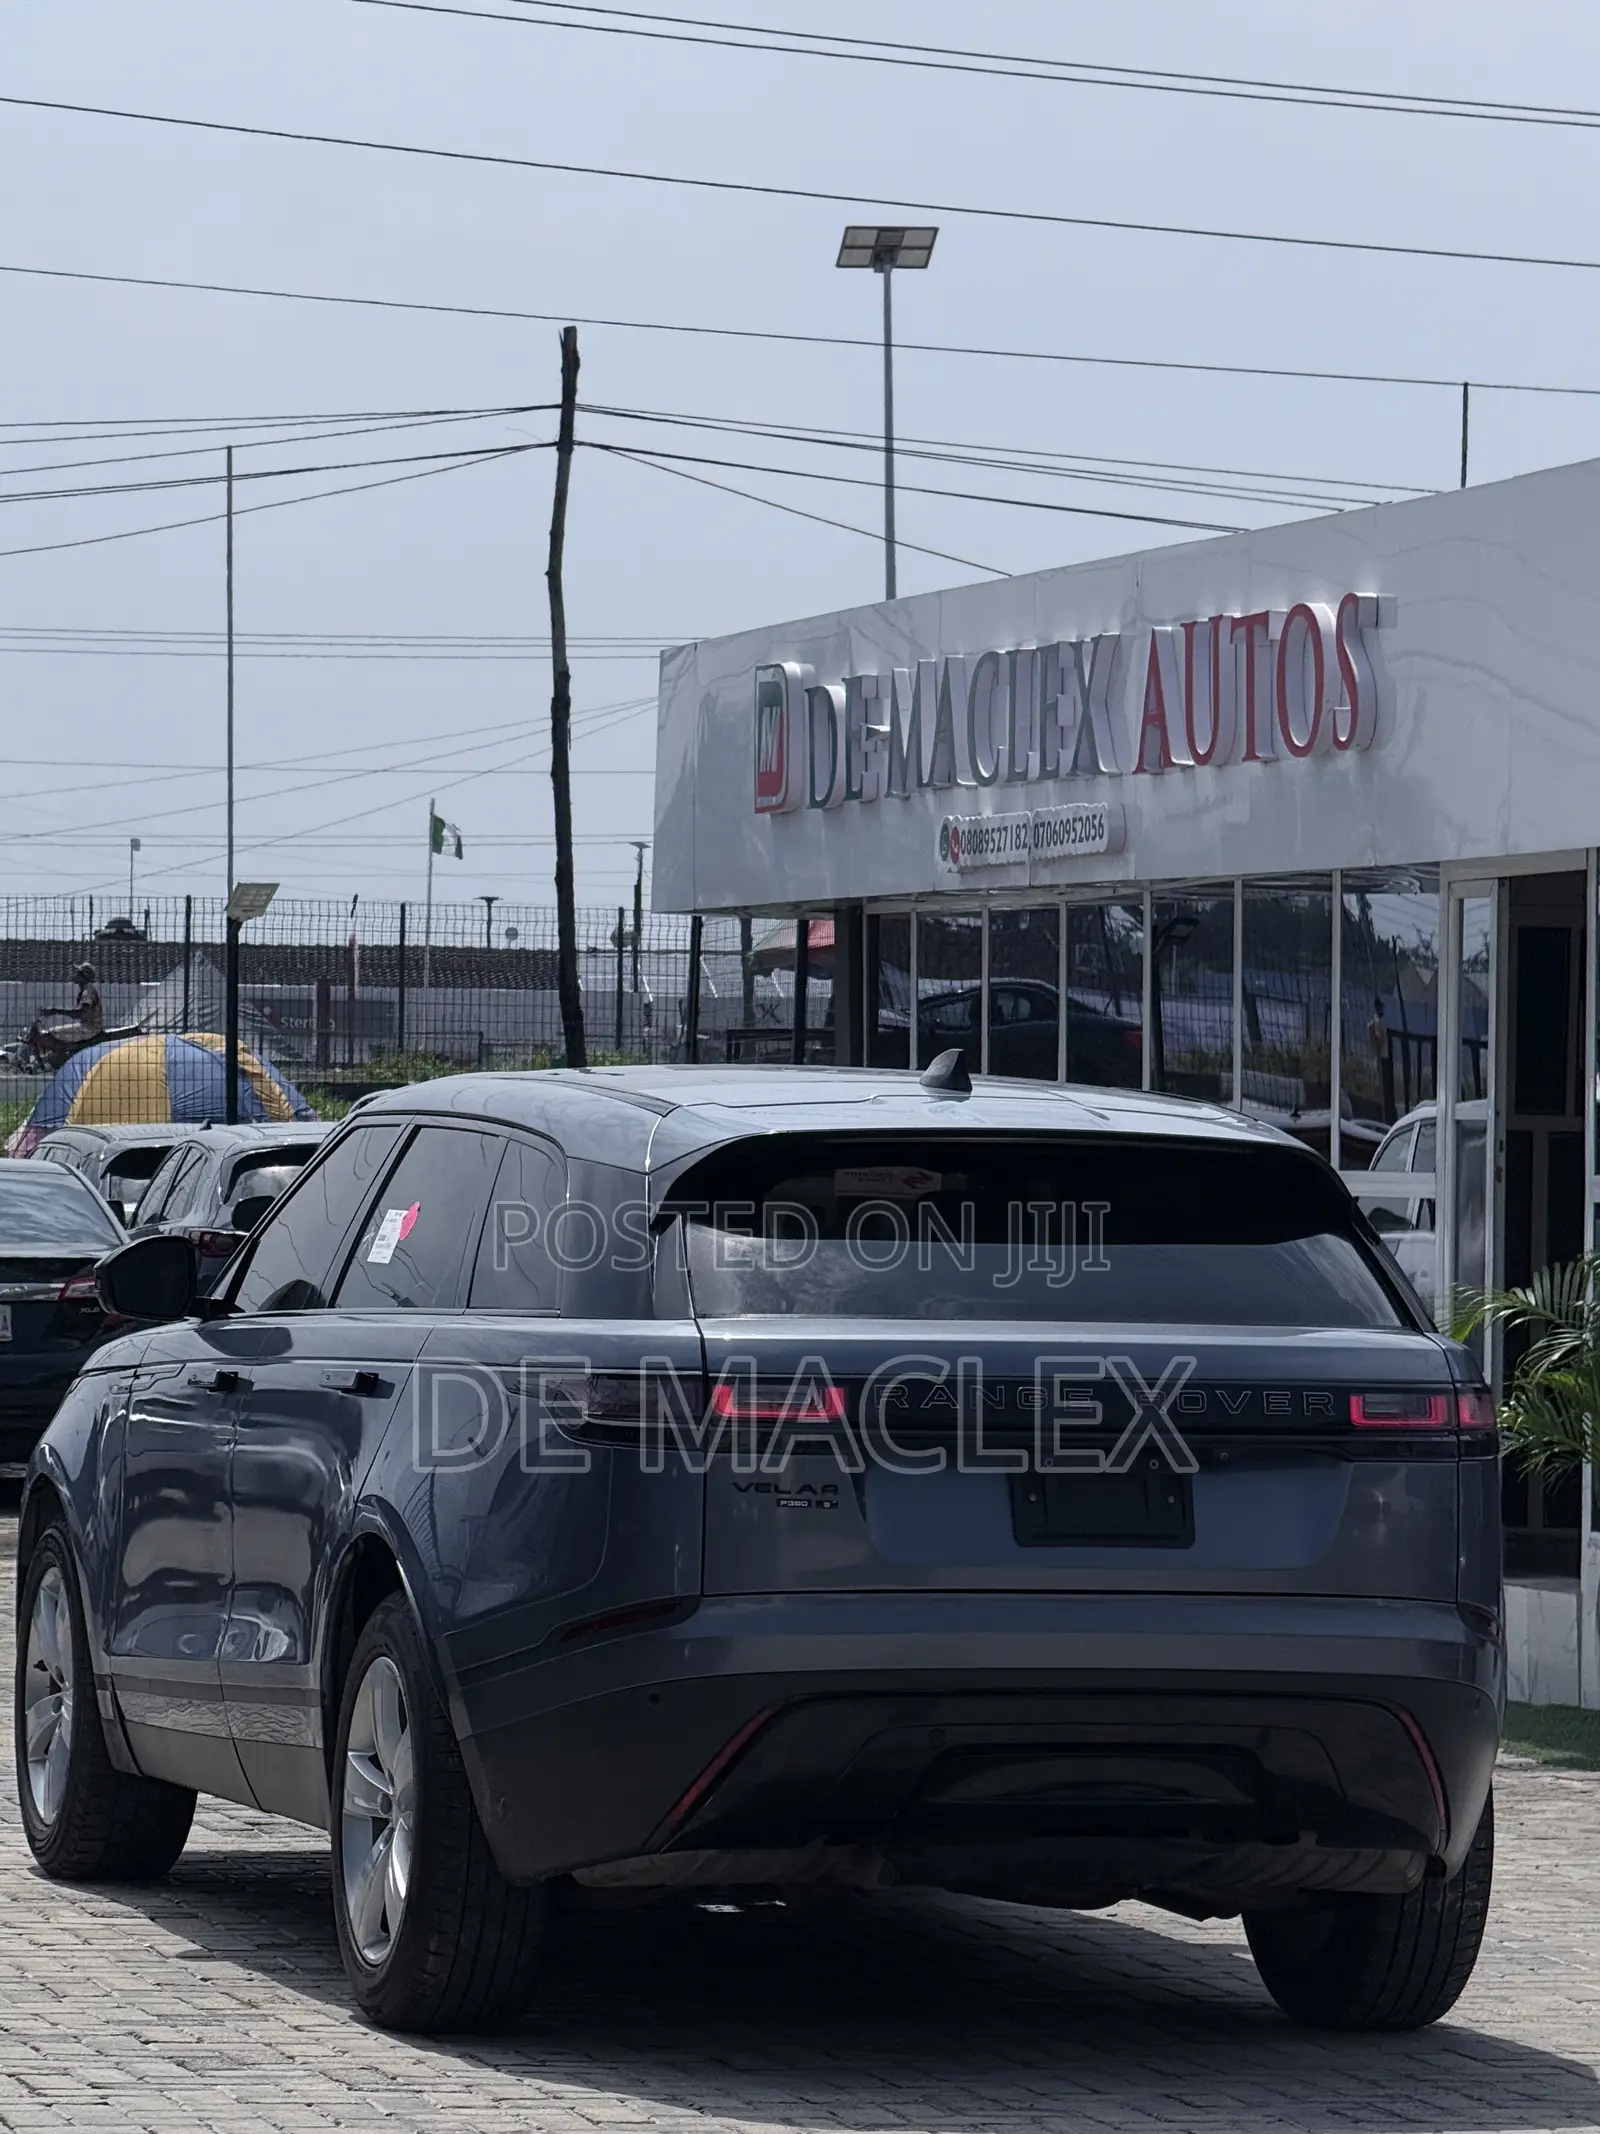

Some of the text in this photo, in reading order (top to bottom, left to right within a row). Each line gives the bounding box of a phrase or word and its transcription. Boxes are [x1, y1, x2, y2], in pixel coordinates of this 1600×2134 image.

[1133, 592, 1378, 775] AUTOS
[1033, 814, 1105, 849] 07060952056
[873, 1384, 1336, 1416] RANGE ROVER
[732, 1482, 840, 1496] VELAR
